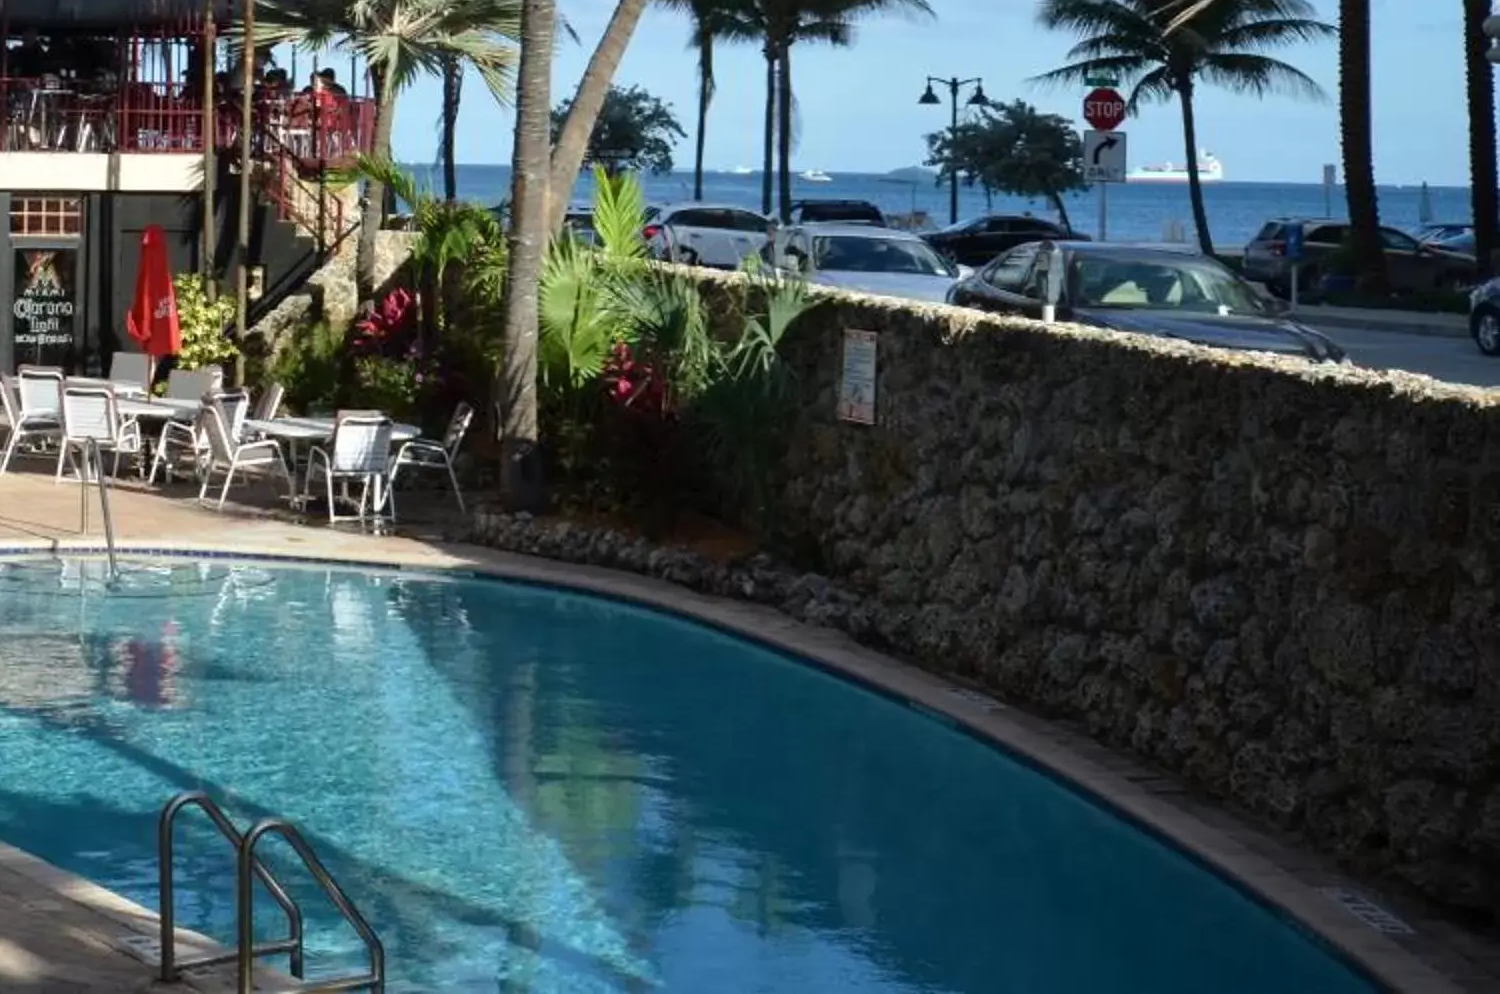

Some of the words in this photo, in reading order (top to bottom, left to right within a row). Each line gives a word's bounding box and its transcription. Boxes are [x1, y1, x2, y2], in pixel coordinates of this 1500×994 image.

[1086, 102, 1123, 118] STOP
[24, 288, 65, 297] MIAMI
[14, 298, 73, 320] Corona
